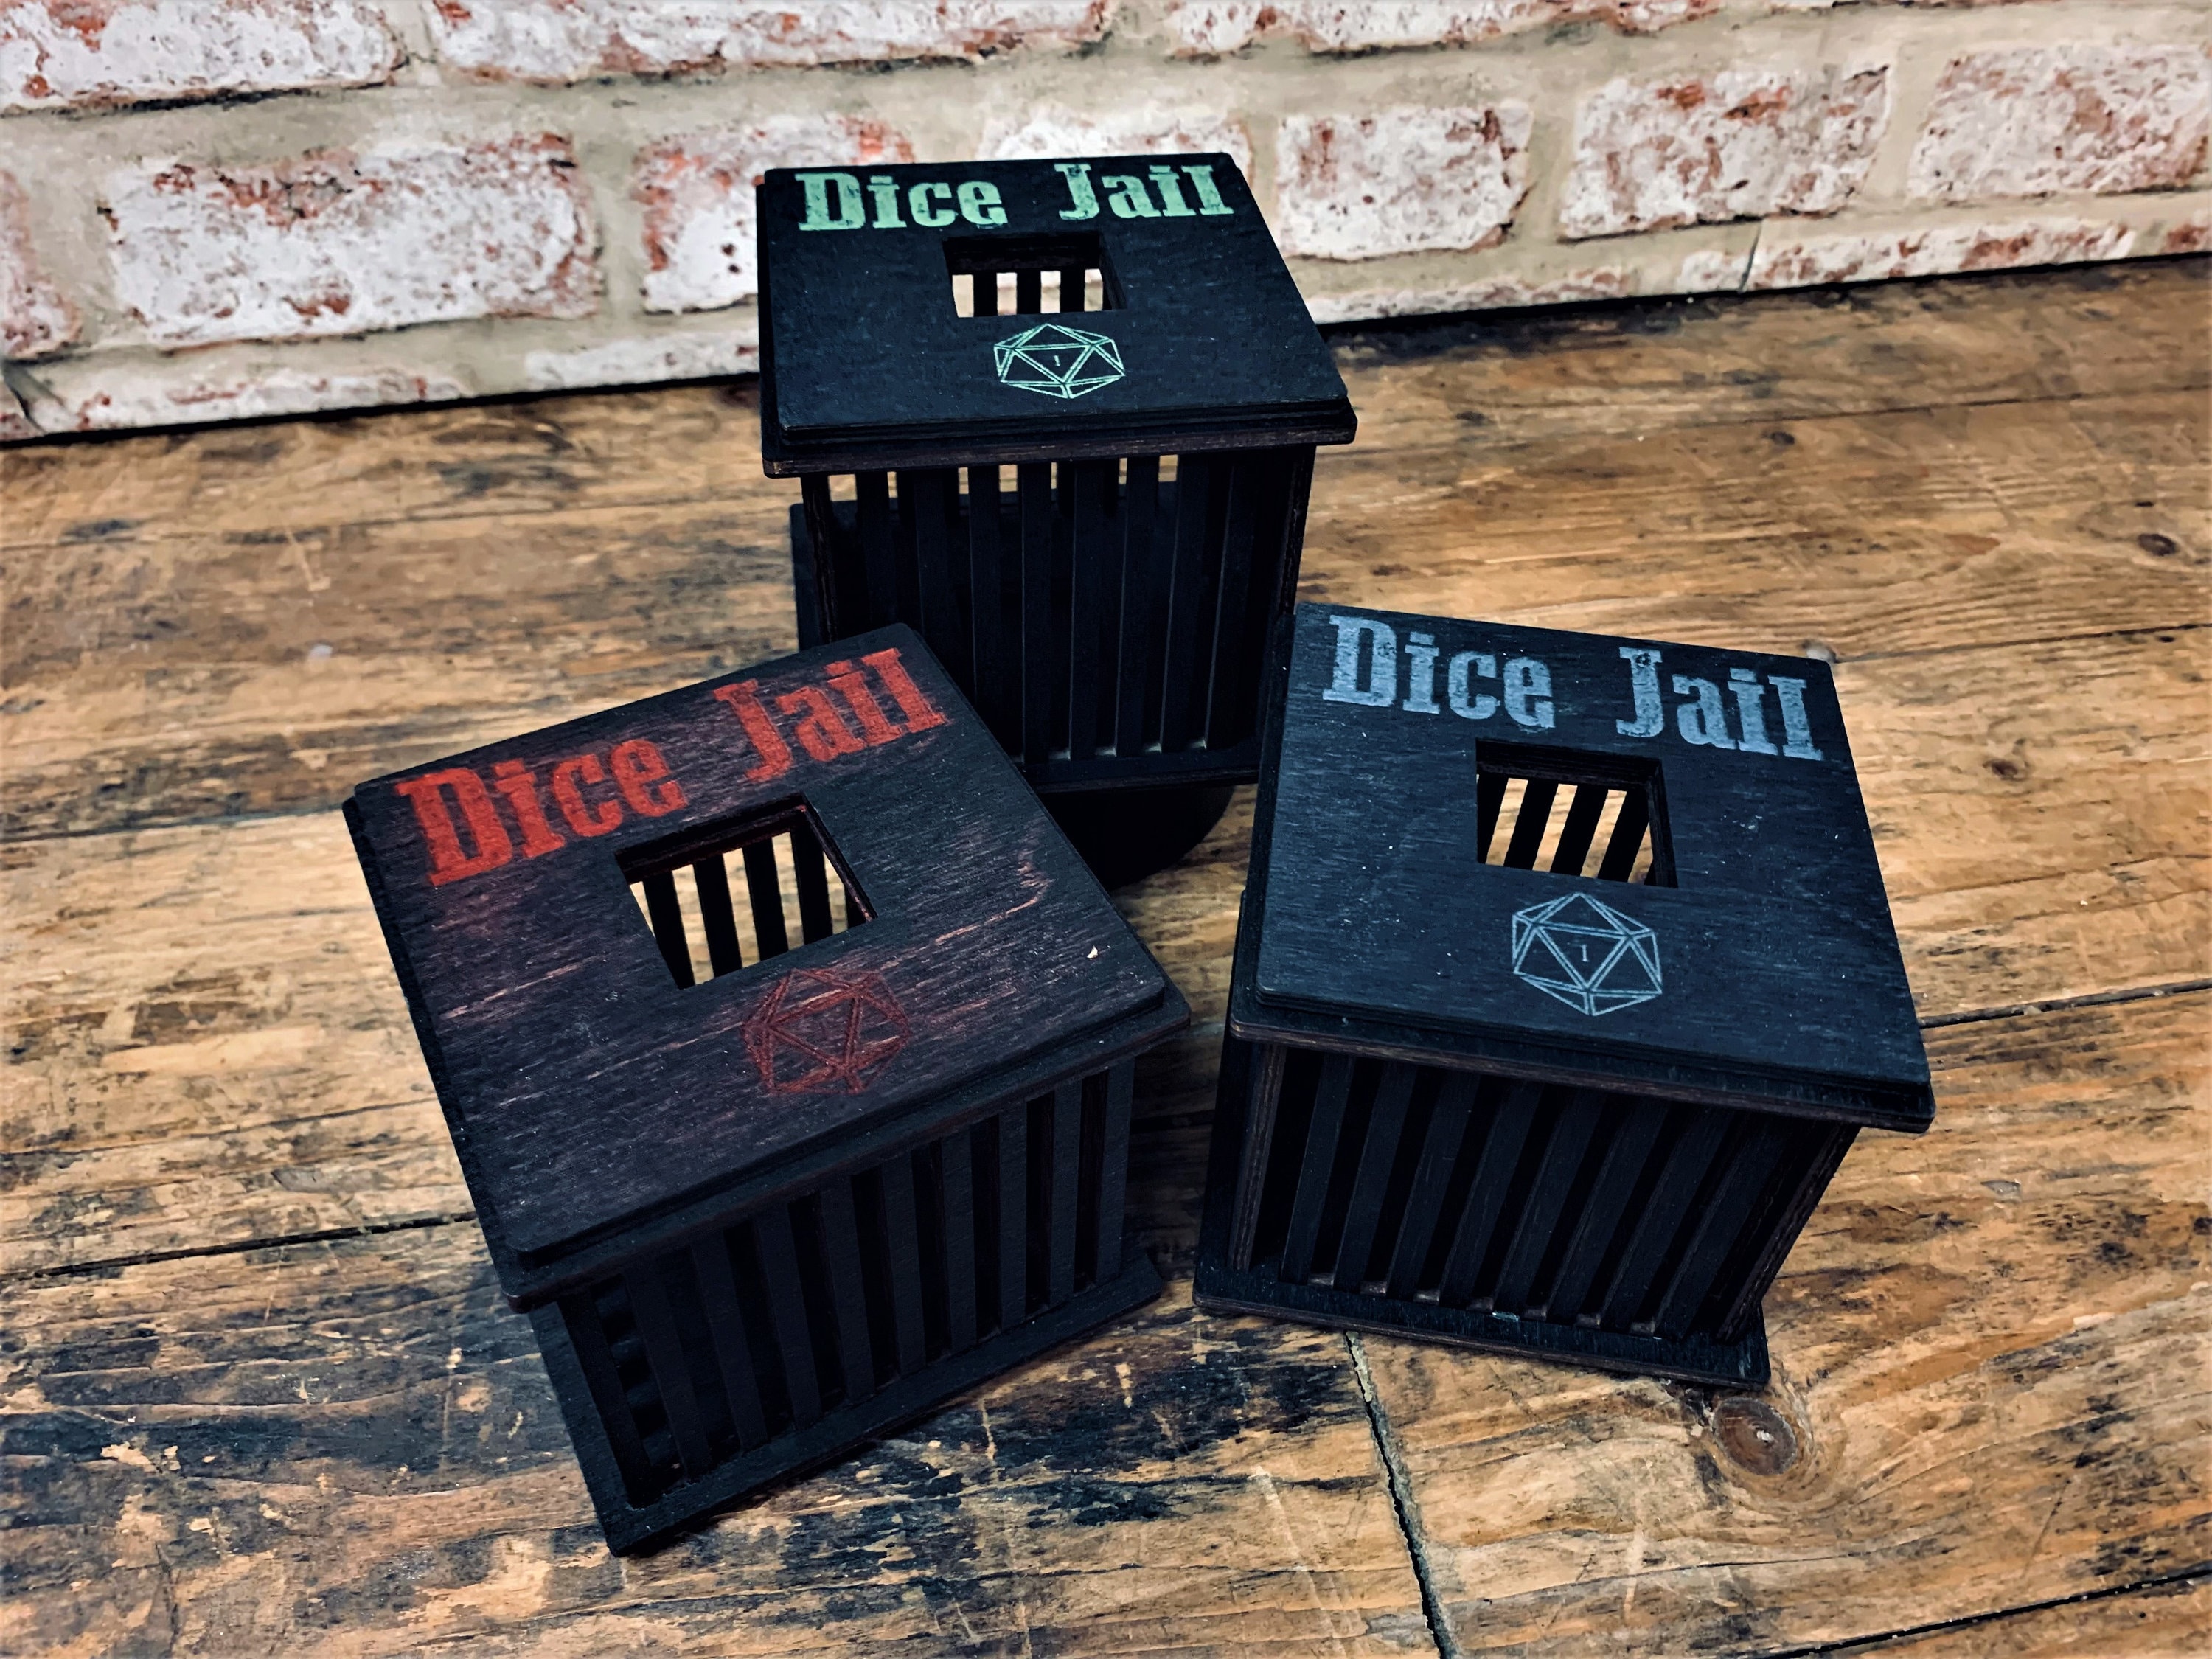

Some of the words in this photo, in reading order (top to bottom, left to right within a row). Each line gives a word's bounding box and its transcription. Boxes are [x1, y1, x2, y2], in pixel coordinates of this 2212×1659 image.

[795, 171, 1008, 232] Dice
[1054, 163, 1234, 221] Jail
[1323, 613, 1555, 731] Dice
[1615, 646, 1825, 761] Jail
[394, 738, 689, 886] Dice
[714, 647, 951, 783] Jail
[1580, 944, 1589, 962] 1
